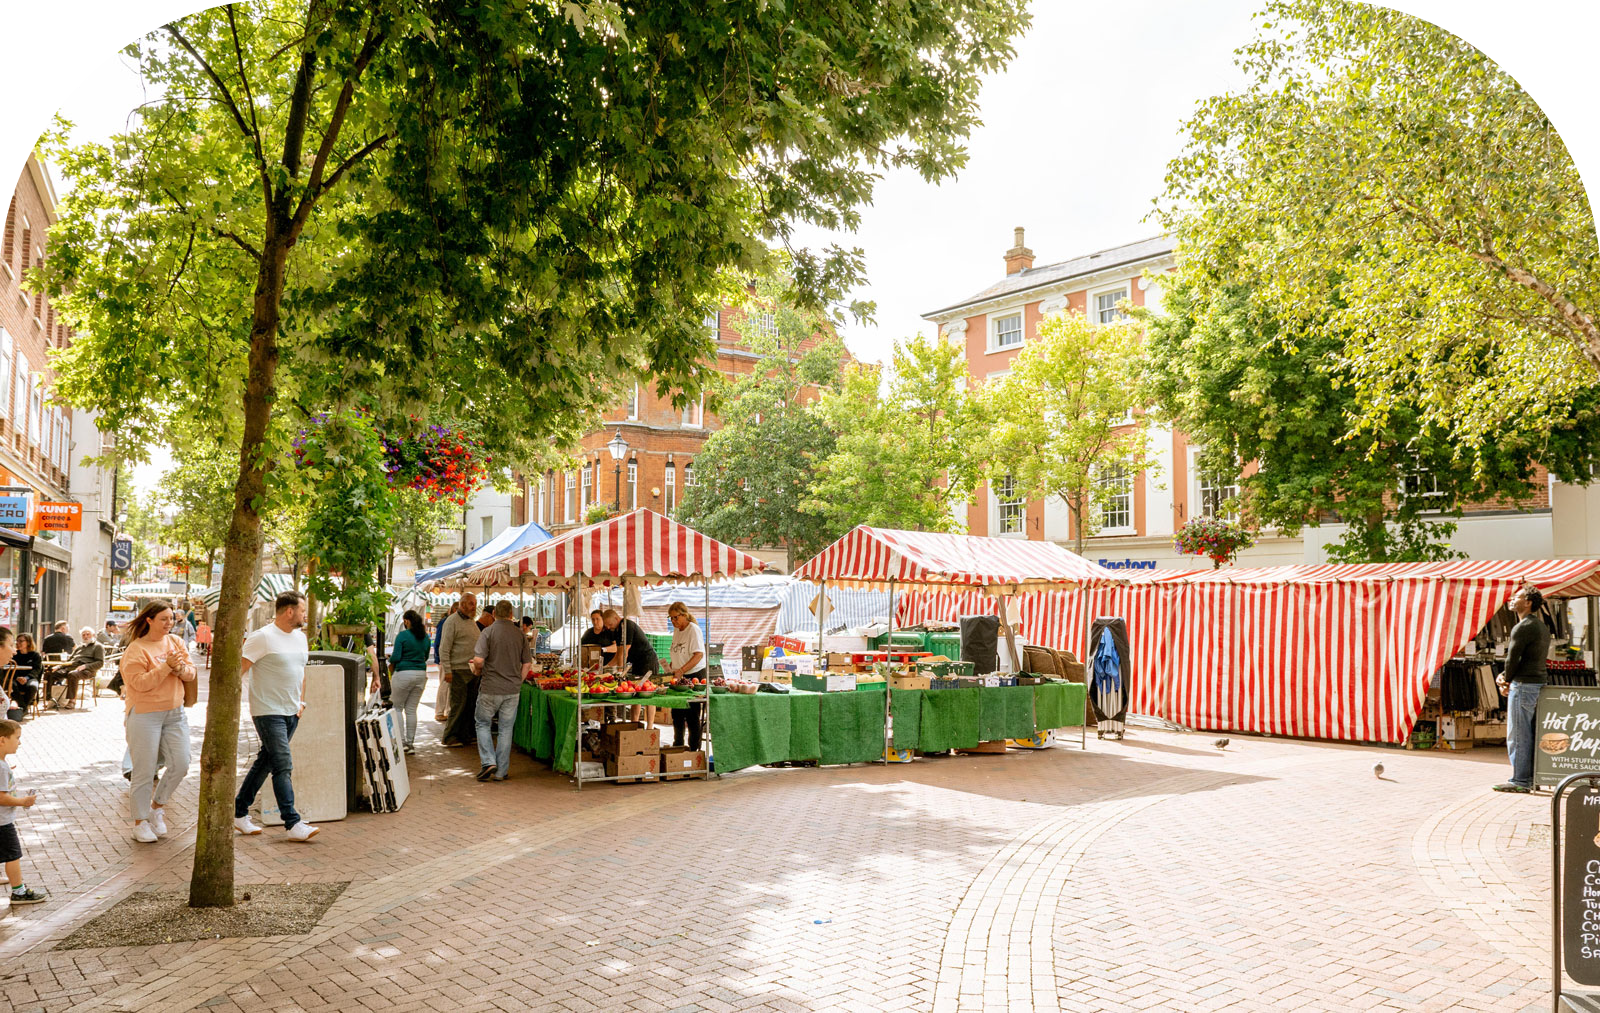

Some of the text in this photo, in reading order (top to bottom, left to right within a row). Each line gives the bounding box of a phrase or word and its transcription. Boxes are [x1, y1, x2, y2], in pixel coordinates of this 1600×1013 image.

[115, 548, 129, 569] S
[1542, 712, 1600, 731] Hot Por
[1586, 860, 1600, 873] C
[1581, 898, 1600, 909] Tu
[1581, 921, 1600, 932] Co
[1580, 933, 1600, 945] Pi
